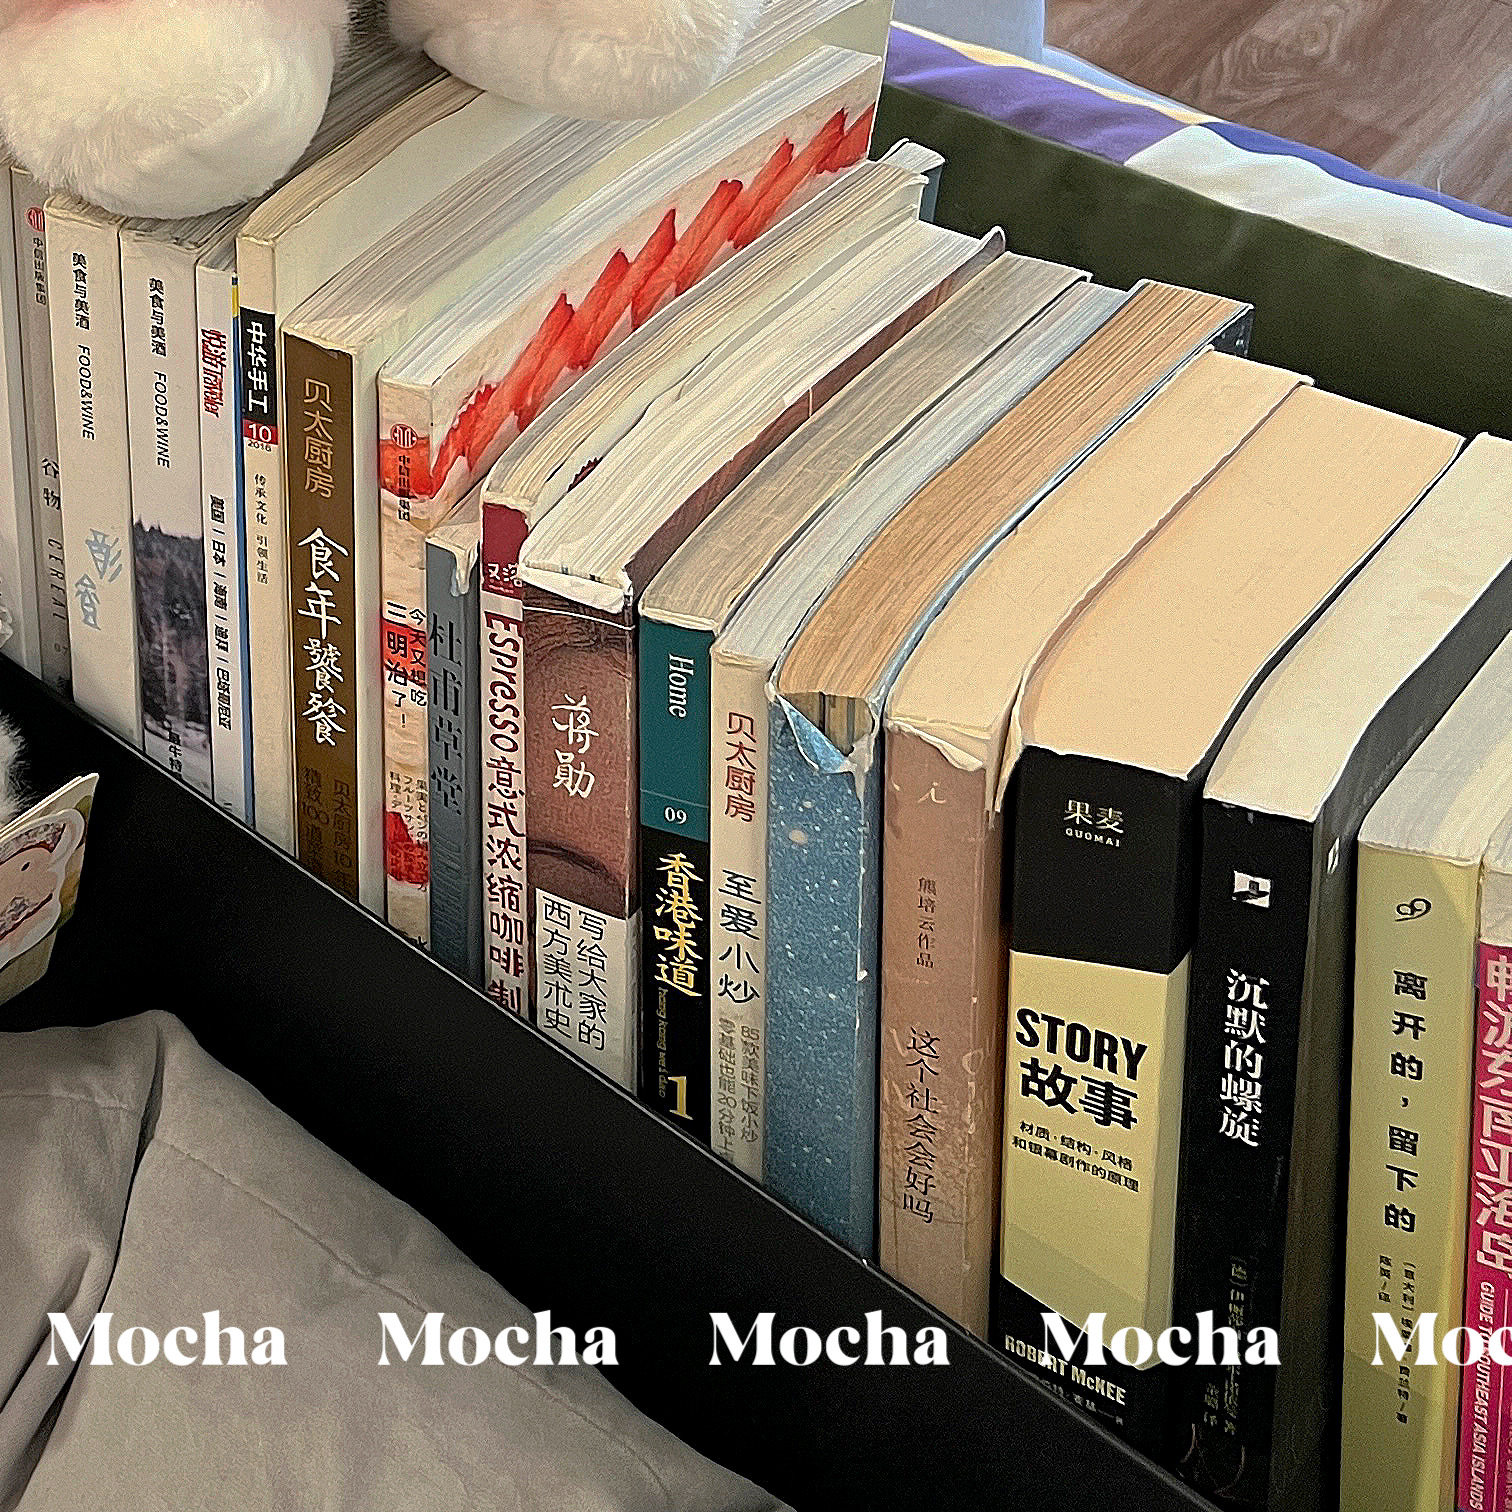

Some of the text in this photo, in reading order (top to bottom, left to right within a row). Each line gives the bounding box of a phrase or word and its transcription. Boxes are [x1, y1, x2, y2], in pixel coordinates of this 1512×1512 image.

[72, 252, 90, 331] 美食与美酒
[149, 277, 167, 357] 美食与美酒
[77, 344, 96, 440] FOOD&WINE
[246, 321, 268, 414] 中华手工
[153, 371, 170, 469] FOOD&WINE
[248, 424, 272, 443] 10
[303, 378, 335, 499] 贝太厨房
[254, 473, 269, 585] 传承文化 引领生活
[429, 613, 463, 815] 杜甫草堂
[668, 653, 695, 718] Home
[551, 694, 600, 799] 蒋勋
[725, 711, 757, 823] 贝太厨房
[664, 806, 687, 825] 09
[1063, 799, 1125, 834] 果麦
[1065, 828, 1120, 847] GUOMAI
[542, 895, 573, 1039] 西方美术史
[653, 852, 704, 997] 香港味道
[718, 869, 761, 1004] 至爱小炒
[576, 908, 608, 1051] 写给大家的
[1015, 1008, 1148, 1081] STORY
[1020, 1056, 1138, 1130] 故事
[1219, 968, 1270, 1147] 沉默的螺旋
[667, 1075, 694, 1121] 1
[902, 1026, 941, 1224] 这个社会会好吗
